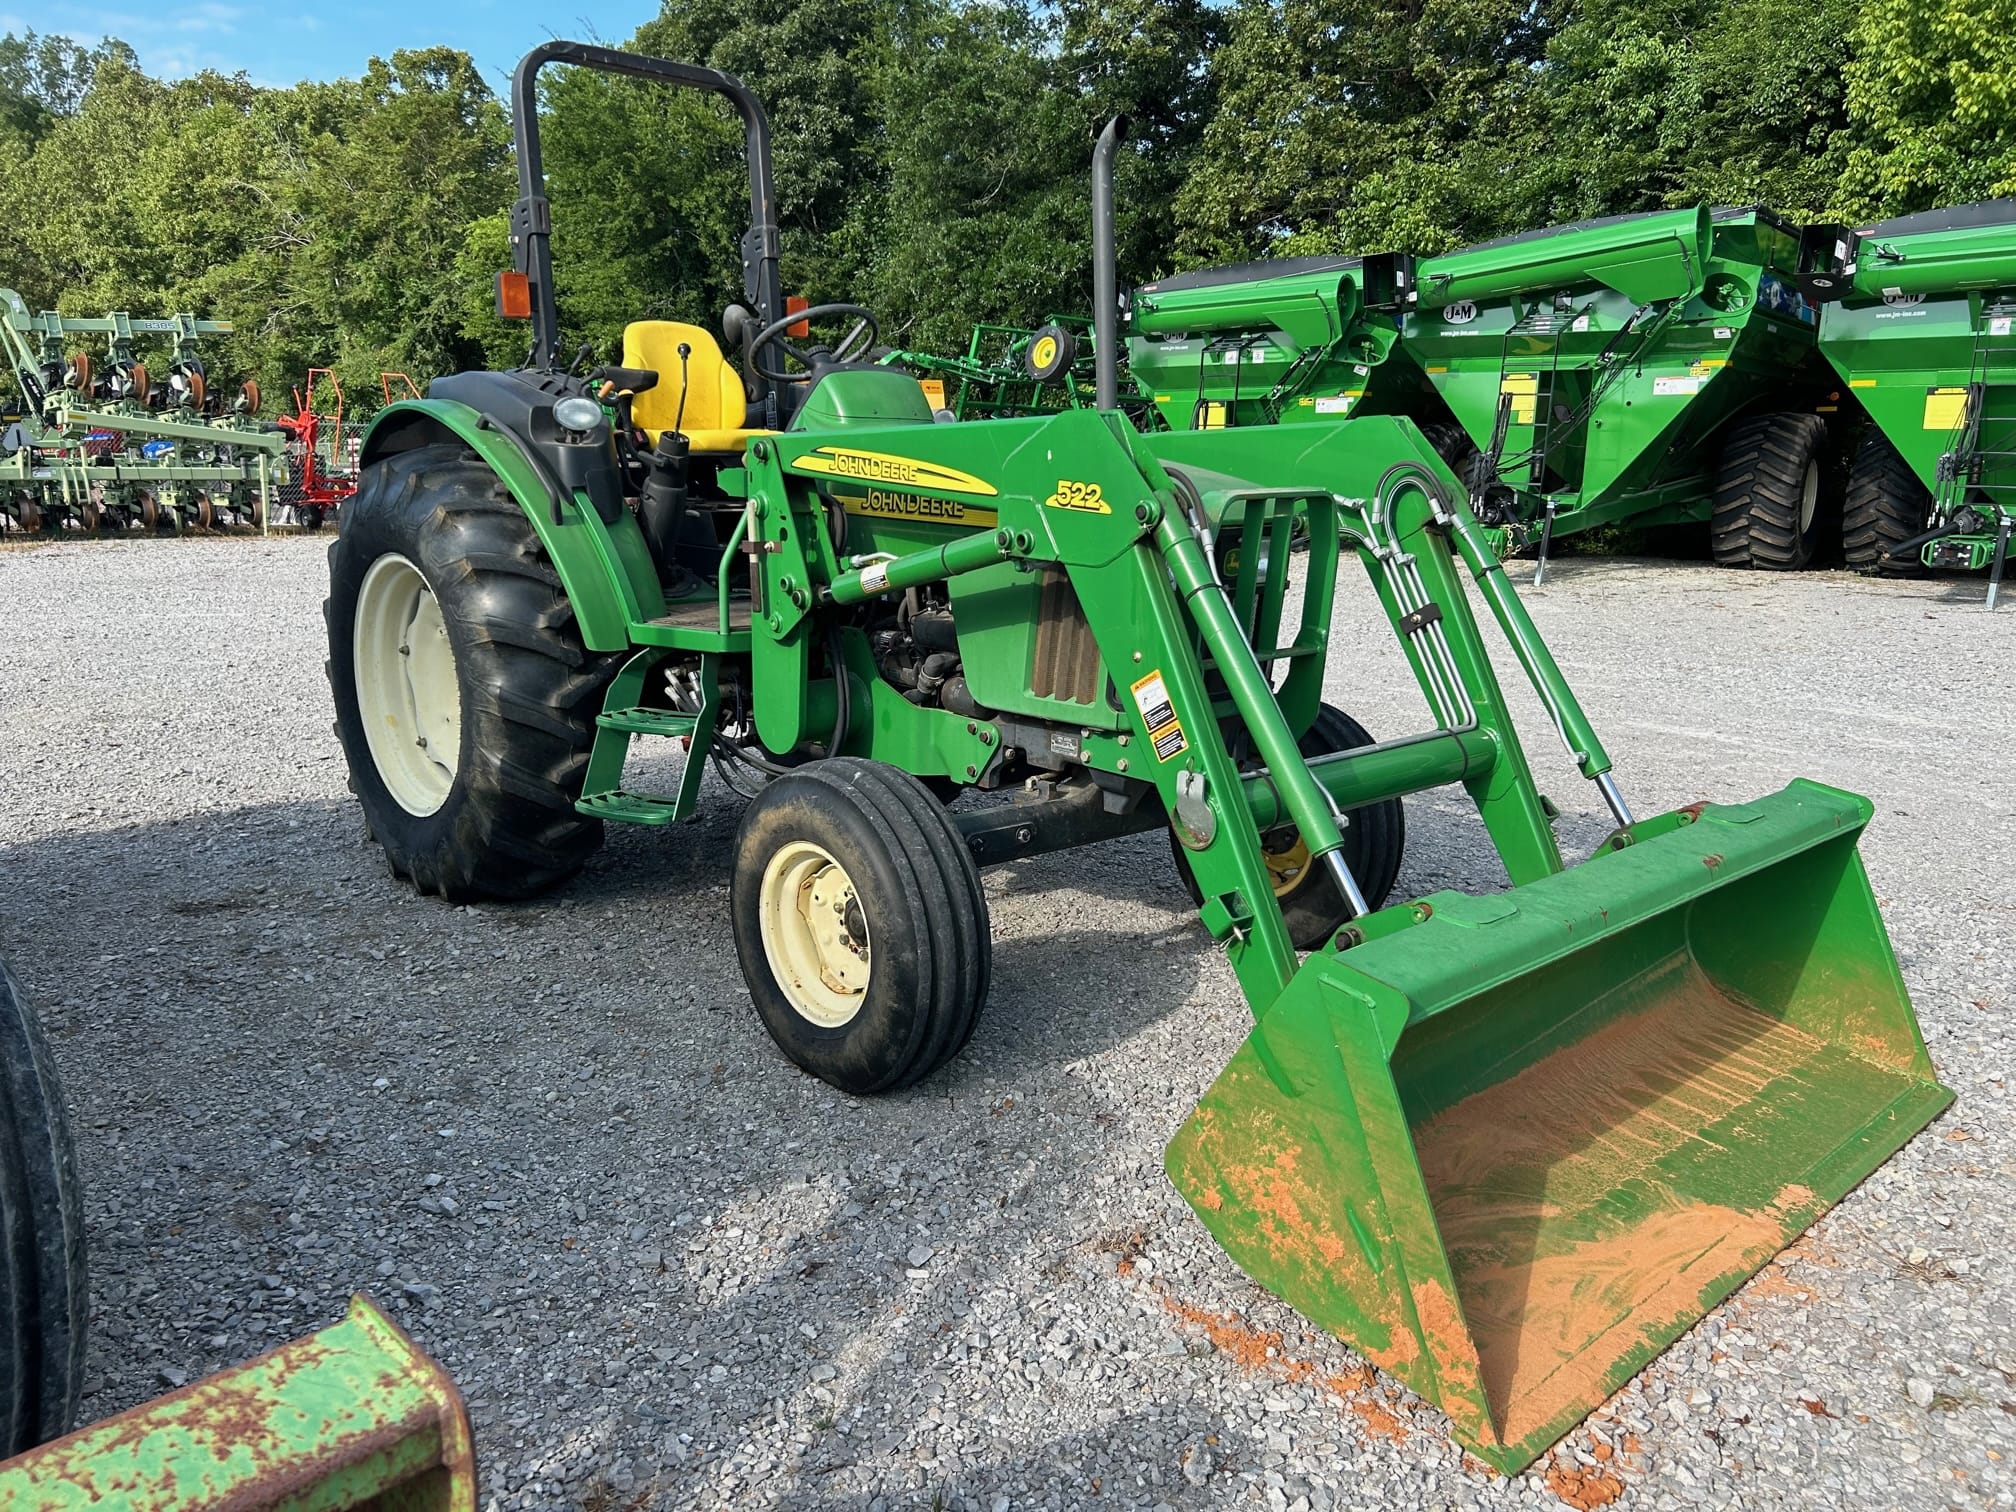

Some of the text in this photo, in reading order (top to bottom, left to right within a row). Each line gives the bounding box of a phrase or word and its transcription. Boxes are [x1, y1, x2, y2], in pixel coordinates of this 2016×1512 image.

[1446, 305, 1472, 319] J&M
[829, 453, 918, 481] JOHN DEERE
[861, 488, 965, 518] JOHN DEERE
[1056, 479, 1101, 511] 522
